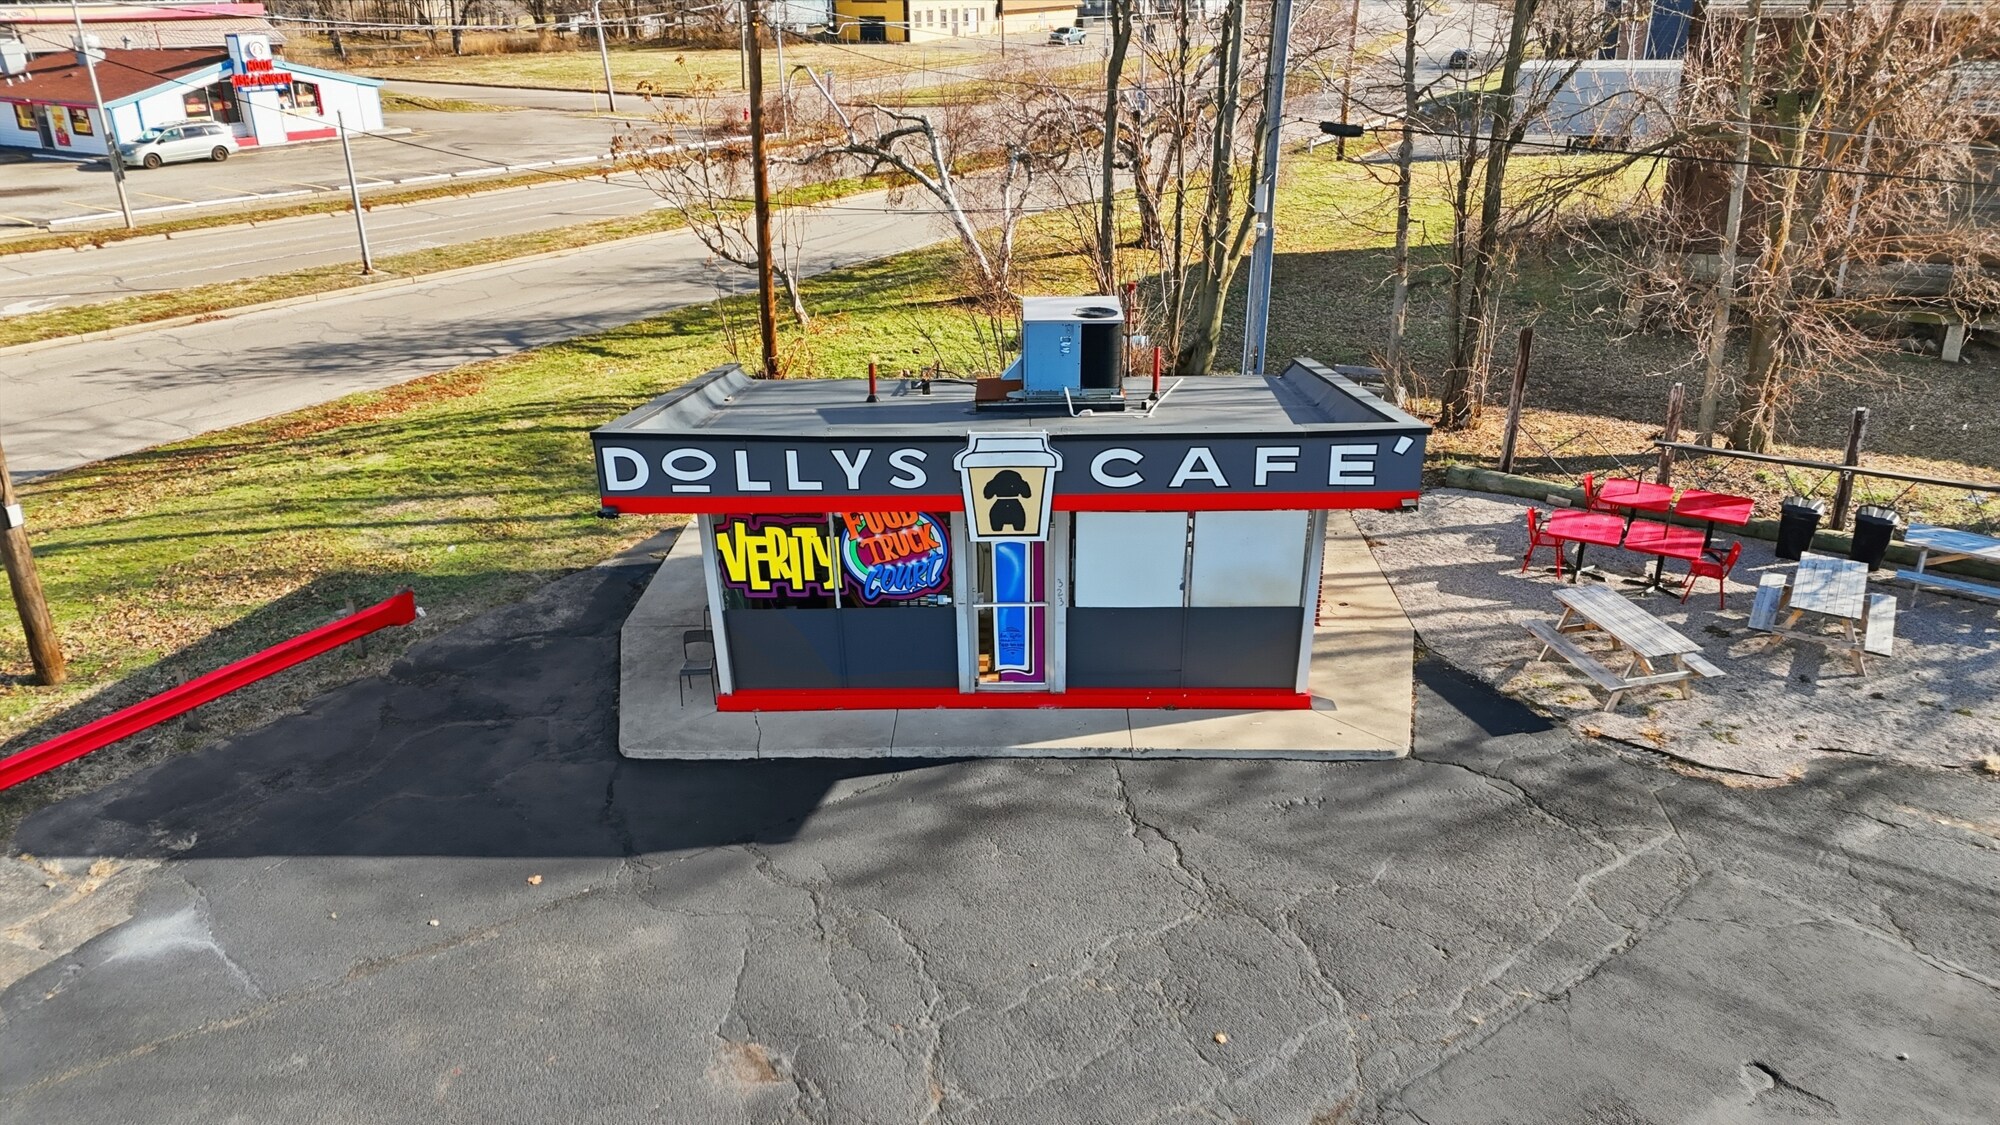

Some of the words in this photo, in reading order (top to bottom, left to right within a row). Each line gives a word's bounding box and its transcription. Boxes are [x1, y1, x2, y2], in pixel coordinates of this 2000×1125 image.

[601, 447, 928, 493] DOLLYS
[716, 521, 843, 590] VERITY
[858, 522, 940, 565] TRUCK
[1056, 578, 1065, 607] 323
